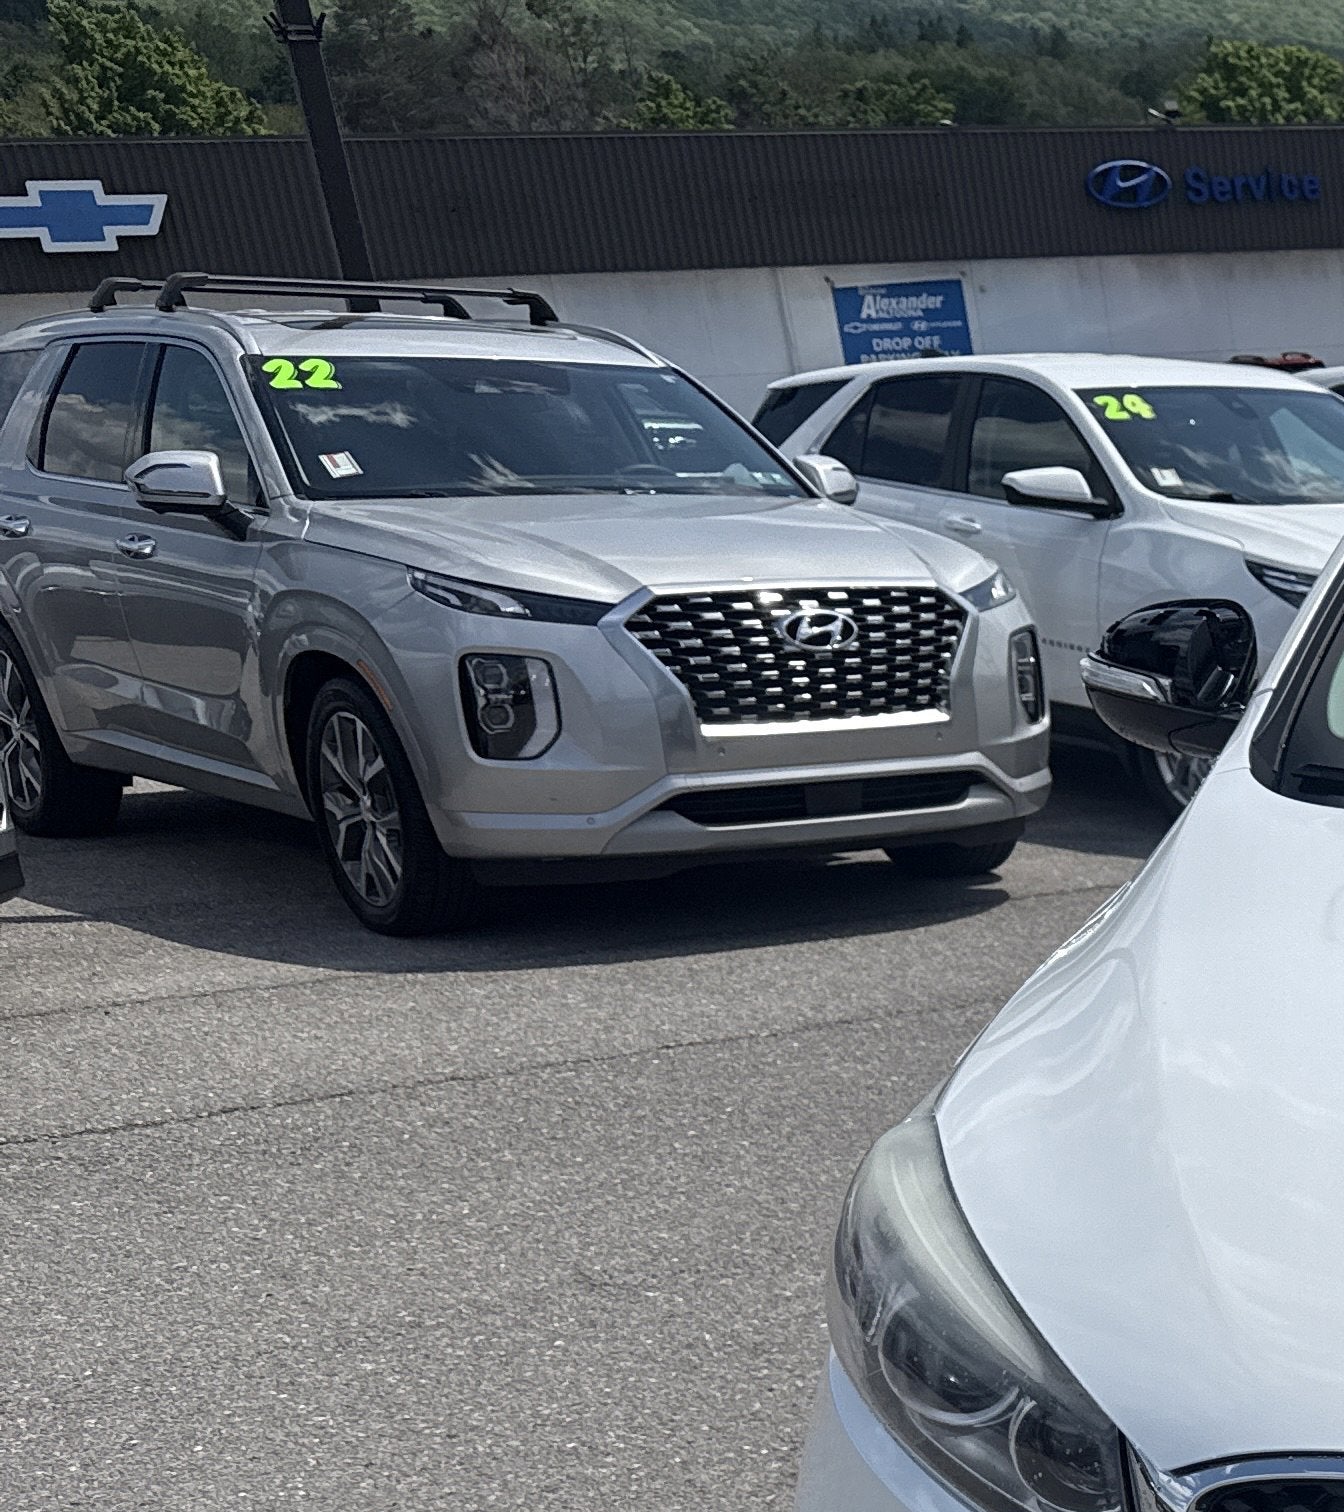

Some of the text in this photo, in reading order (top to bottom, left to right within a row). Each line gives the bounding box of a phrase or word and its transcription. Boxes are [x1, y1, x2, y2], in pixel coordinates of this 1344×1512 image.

[1183, 165, 1322, 205] Service
[860, 292, 944, 320] Alexander
[871, 335, 942, 352] DROP OFF
[261, 358, 343, 390] 22
